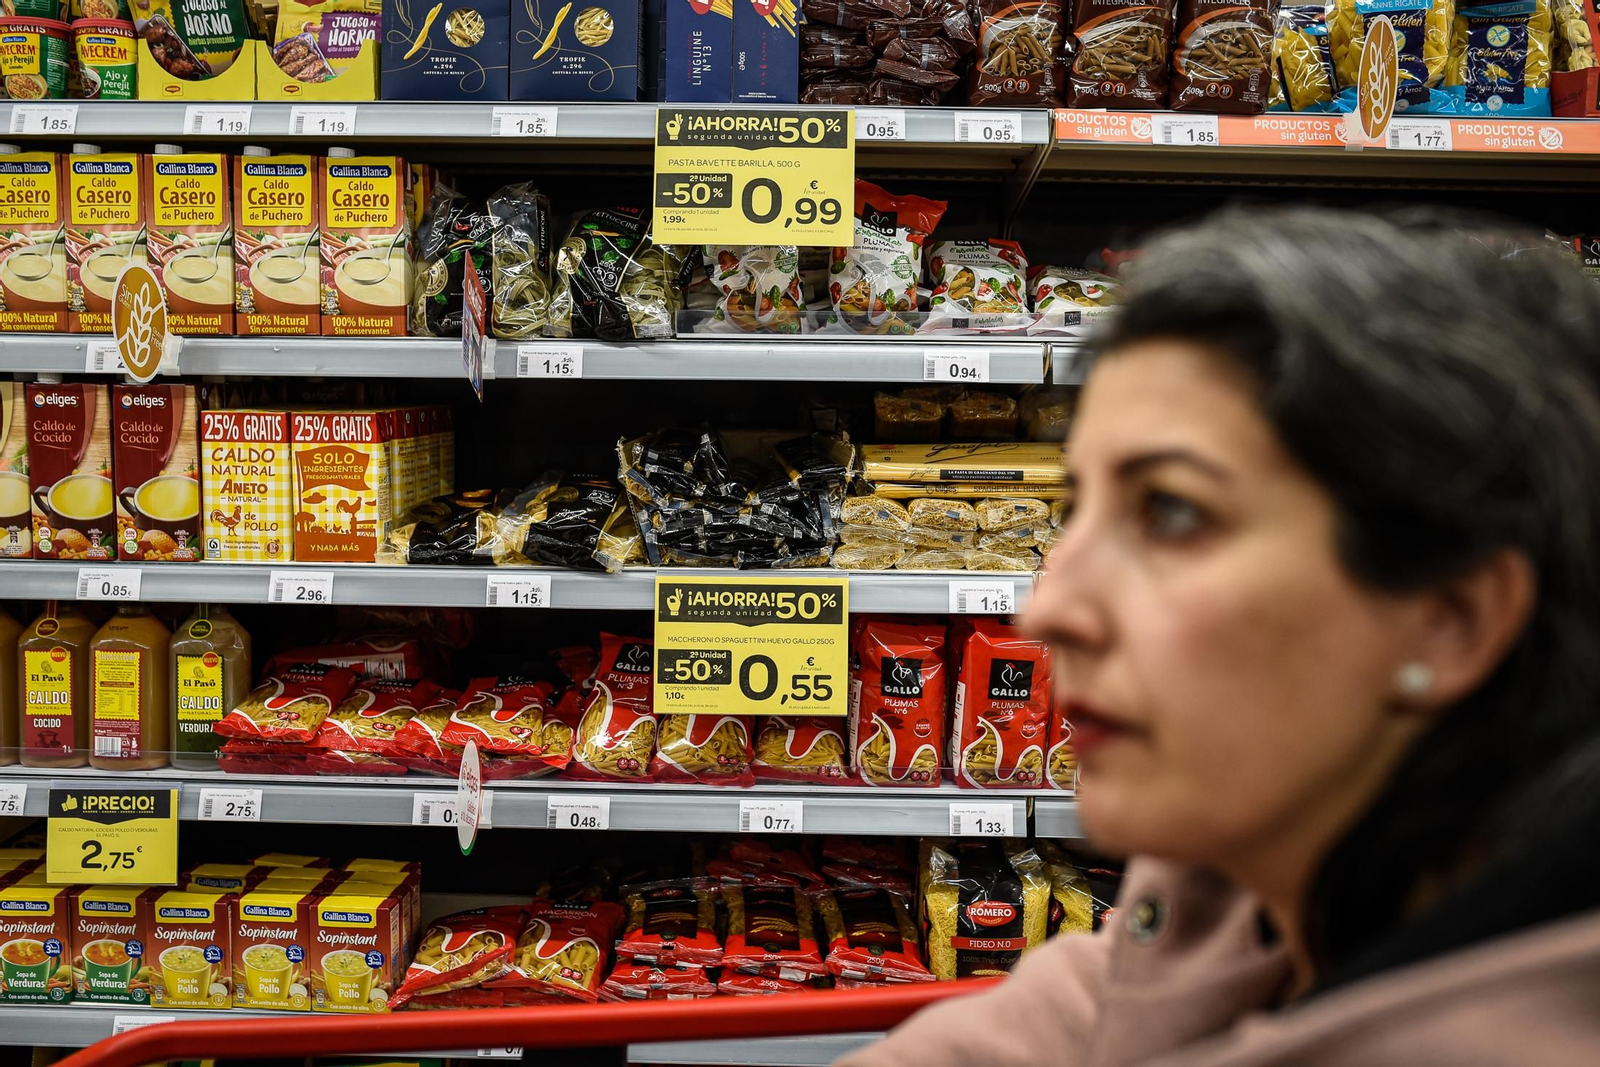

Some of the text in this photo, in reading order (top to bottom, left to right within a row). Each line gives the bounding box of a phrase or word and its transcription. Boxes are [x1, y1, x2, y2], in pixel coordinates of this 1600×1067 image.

[184, 13, 233, 36] HORNO
[211, 35, 236, 45] provenzales
[81, 45, 128, 61] AVECREM
[692, 31, 702, 86] LINGUINE
[103, 79, 130, 92] Perejil
[984, 83, 1002, 93] 500g
[687, 116, 778, 132] ¡AHORRA!
[1055, 112, 1127, 126] PRODUCTOS
[1076, 124, 1127, 137] sin gluten
[1254, 120, 1331, 131] PRODUCTOS
[1457, 124, 1535, 136] PRODUCTOS
[687, 133, 775, 142] segunda unidad
[1280, 130, 1332, 142] sin gluten
[1485, 136, 1536, 149] sin gluten
[75, 162, 131, 174] Gallina Blanca
[158, 163, 215, 175] Gallina Blanca
[668, 158, 696, 167] PASTA
[697, 159, 737, 167] BAVETTE
[777, 160, 794, 168] 500
[794, 160, 801, 168] G
[332, 166, 389, 178] Gallina Blanca
[91, 177, 117, 188] Caldo
[175, 178, 201, 189] Caldo
[699, 174, 728, 183] Unidad
[348, 180, 374, 191] Caldo
[809, 180, 819, 190] €
[76, 185, 132, 204] Casero
[159, 187, 217, 205] Casero
[332, 188, 390, 207] Casero
[742, 177, 842, 230] 0,99
[334, 211, 388, 224] de Puchero
[663, 215, 686, 224] 1,99€
[331, 316, 394, 328] 100% Natural
[334, 327, 391, 336] Sin conservantes
[46, 392, 77, 409] eliges
[133, 394, 165, 411] eliges
[33, 420, 76, 433] Caldo de
[204, 414, 282, 441] 25% GRATIS
[295, 415, 373, 442] 25% GRATIS
[33, 431, 72, 444] Cocido
[211, 447, 275, 464] CALDO
[312, 452, 355, 465] SOLO
[211, 464, 275, 477] NATURAL
[303, 465, 364, 473] INGREDIENTES
[973, 485, 1048, 494] SPAGHETTI AL HUEVO
[244, 511, 257, 521] de
[244, 522, 279, 532] POLLO
[310, 542, 360, 552] Y NADA MÁS
[687, 591, 776, 607] ¡AHORRA!
[687, 609, 772, 618] segunda unidad
[667, 636, 714, 644] MACCHERONI
[721, 637, 767, 645] SPAGUETTINI
[767, 637, 793, 645] HUEVO
[792, 638, 816, 646] GALLO
[816, 638, 835, 646] 250G
[700, 651, 727, 660] Unidad
[806, 656, 816, 667] €
[616, 661, 651, 673] GALLO
[31, 674, 41, 682] El
[607, 673, 649, 685] PLUMAS
[739, 654, 833, 706] 0,55
[664, 685, 697, 693] Comprando
[883, 684, 920, 695] GALLO
[991, 687, 1028, 698] GALLO
[29, 690, 68, 705] CALDO
[664, 691, 685, 701] 1,10€
[181, 696, 220, 710] CALDO
[883, 698, 919, 709] PLUMAS
[990, 700, 1025, 710] PLUMAS
[33, 718, 62, 728] COCIDO
[82, 795, 155, 811] ¡PRECIO!
[136, 845, 143, 853] €
[81, 840, 135, 872] 2,75
[84, 901, 130, 912] Gallina Blanca
[970, 907, 1012, 918] ROMERO
[161, 908, 208, 919] Gallina Blanca
[324, 911, 370, 923] Gallina Blanca
[77, 919, 137, 936] Sopinstant
[154, 926, 216, 943] Sopinstant
[316, 929, 378, 947] Sopinstant
[969, 939, 995, 950] FIDEO
[866, 956, 885, 967] 250g
[16, 971, 37, 980] Sopa de
[90, 977, 128, 990] Verduras
[177, 983, 199, 995] Pollo
[338, 988, 361, 1001] Pollo
